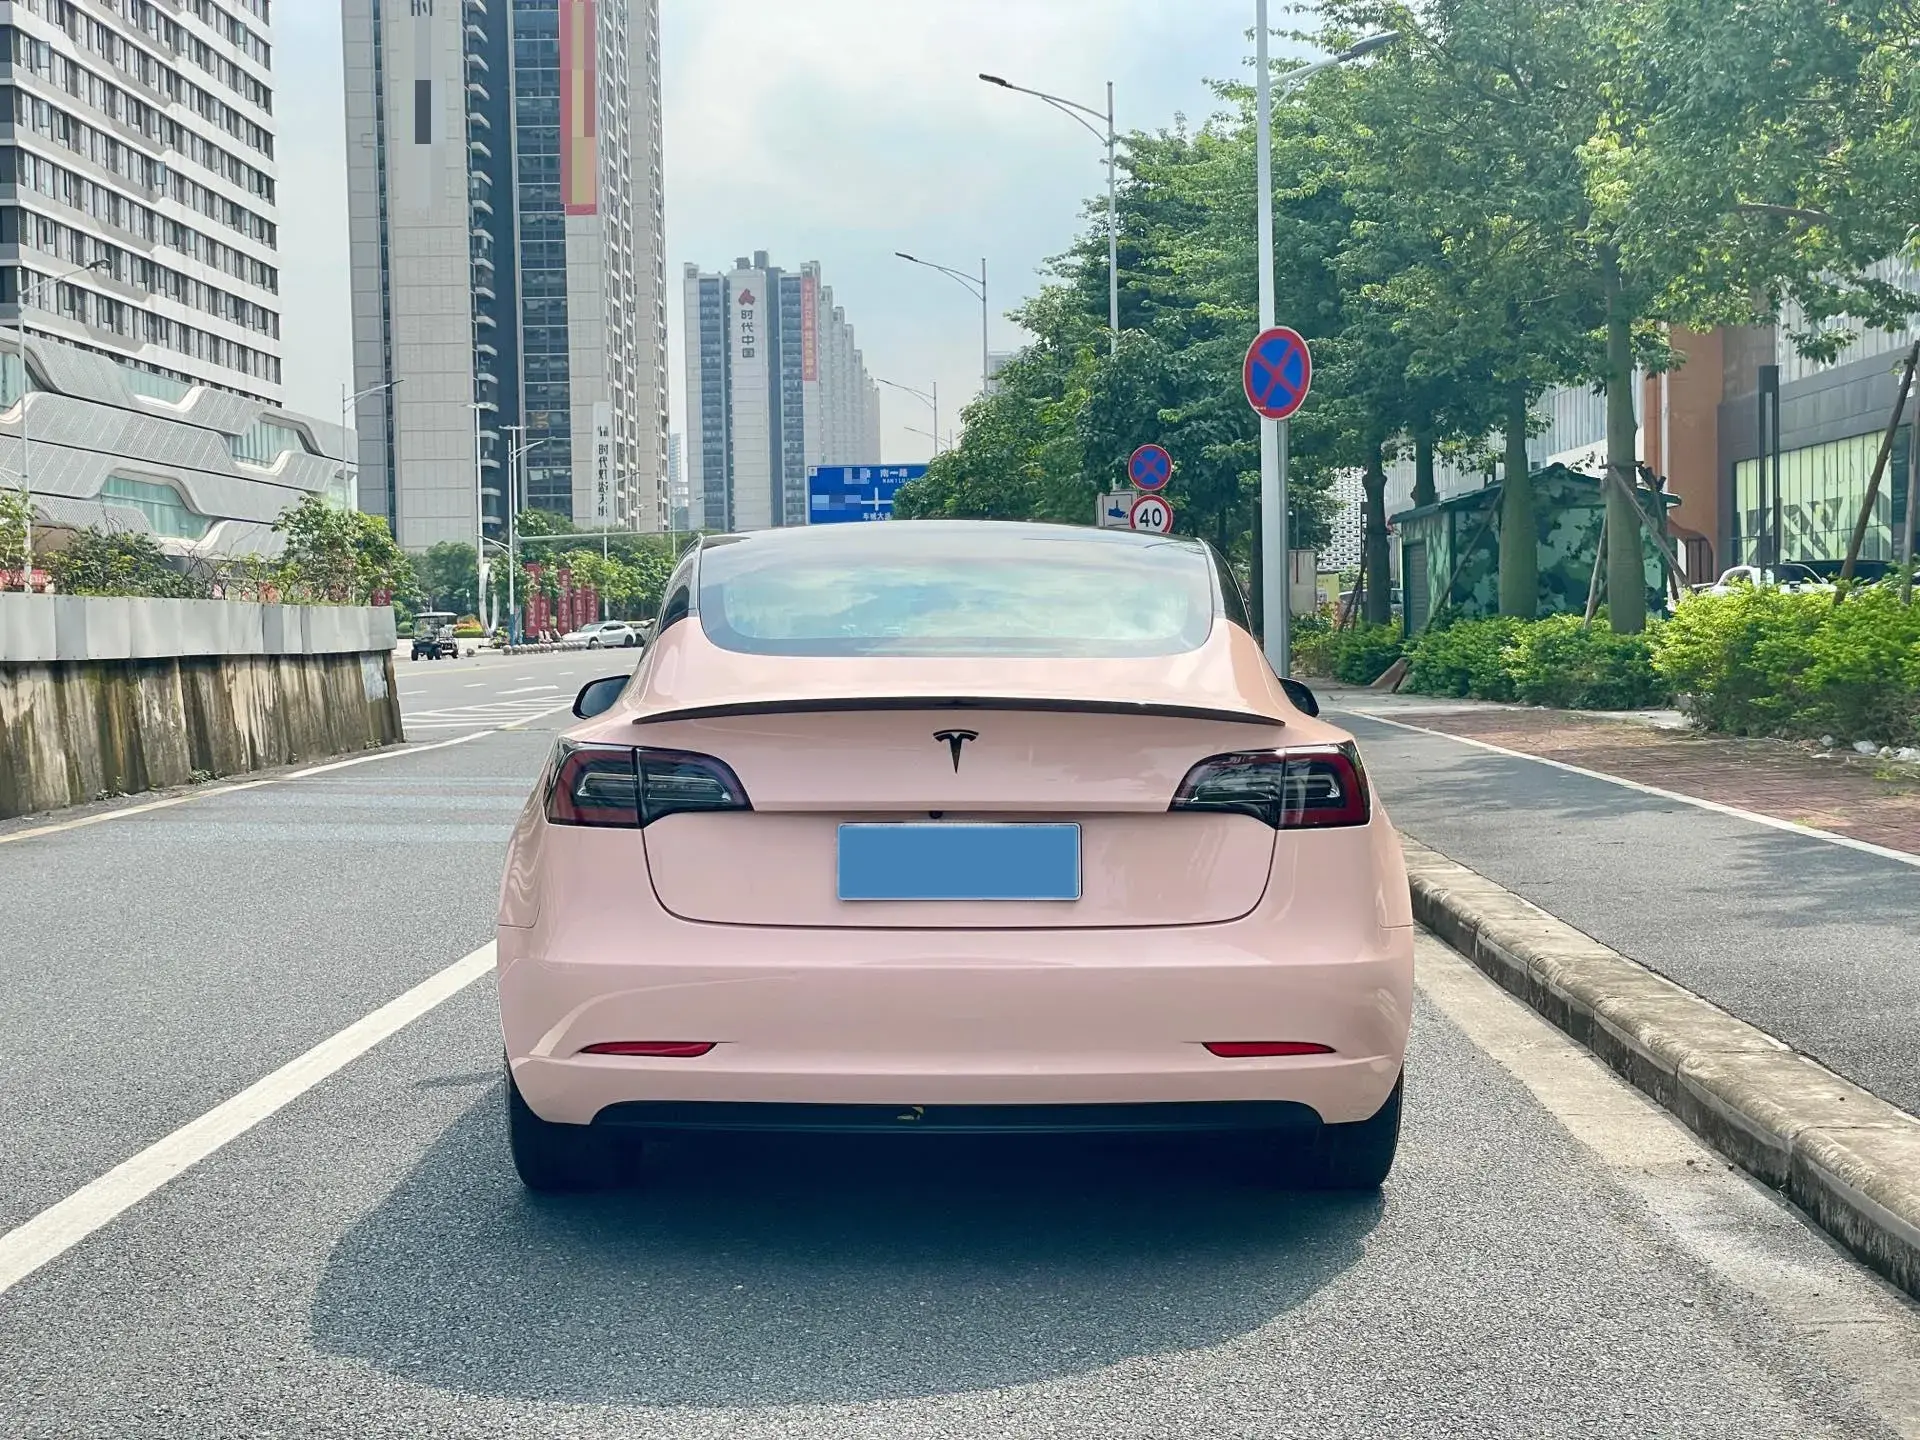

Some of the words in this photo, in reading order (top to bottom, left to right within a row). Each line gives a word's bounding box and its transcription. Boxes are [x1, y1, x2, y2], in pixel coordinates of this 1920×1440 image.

[740, 309, 755, 358] 时代中国
[1139, 508, 1162, 528] 40
